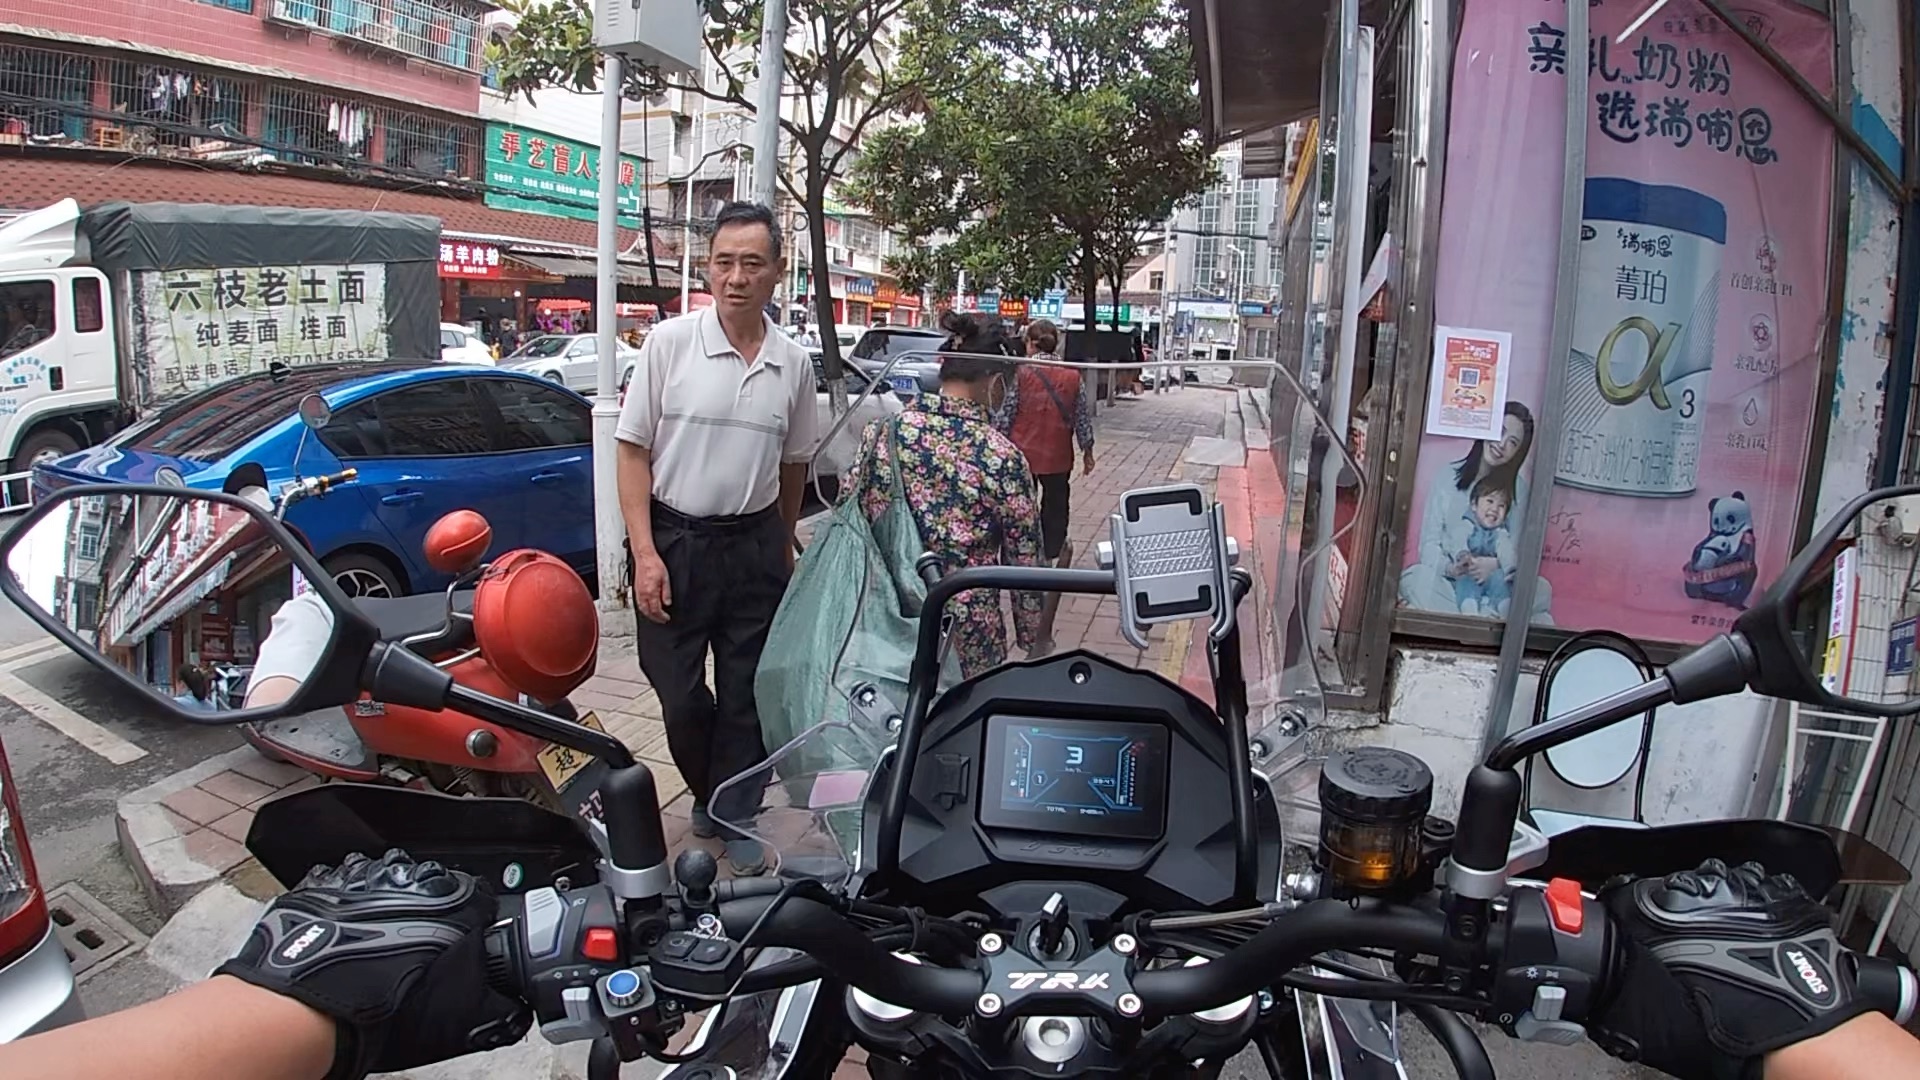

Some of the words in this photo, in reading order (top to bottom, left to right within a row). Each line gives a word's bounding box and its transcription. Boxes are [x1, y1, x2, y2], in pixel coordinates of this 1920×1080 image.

[501, 130, 636, 187] 手艺盲人摩
[167, 268, 365, 312] 六枝老土面
[196, 317, 279, 348] 纯麦面
[300, 314, 347, 341] 挂面
[1679, 388, 1697, 419] 3
[1065, 746, 1083, 764] 3
[1007, 972, 1110, 990] TRK
[1785, 950, 1829, 994] SUOMY
